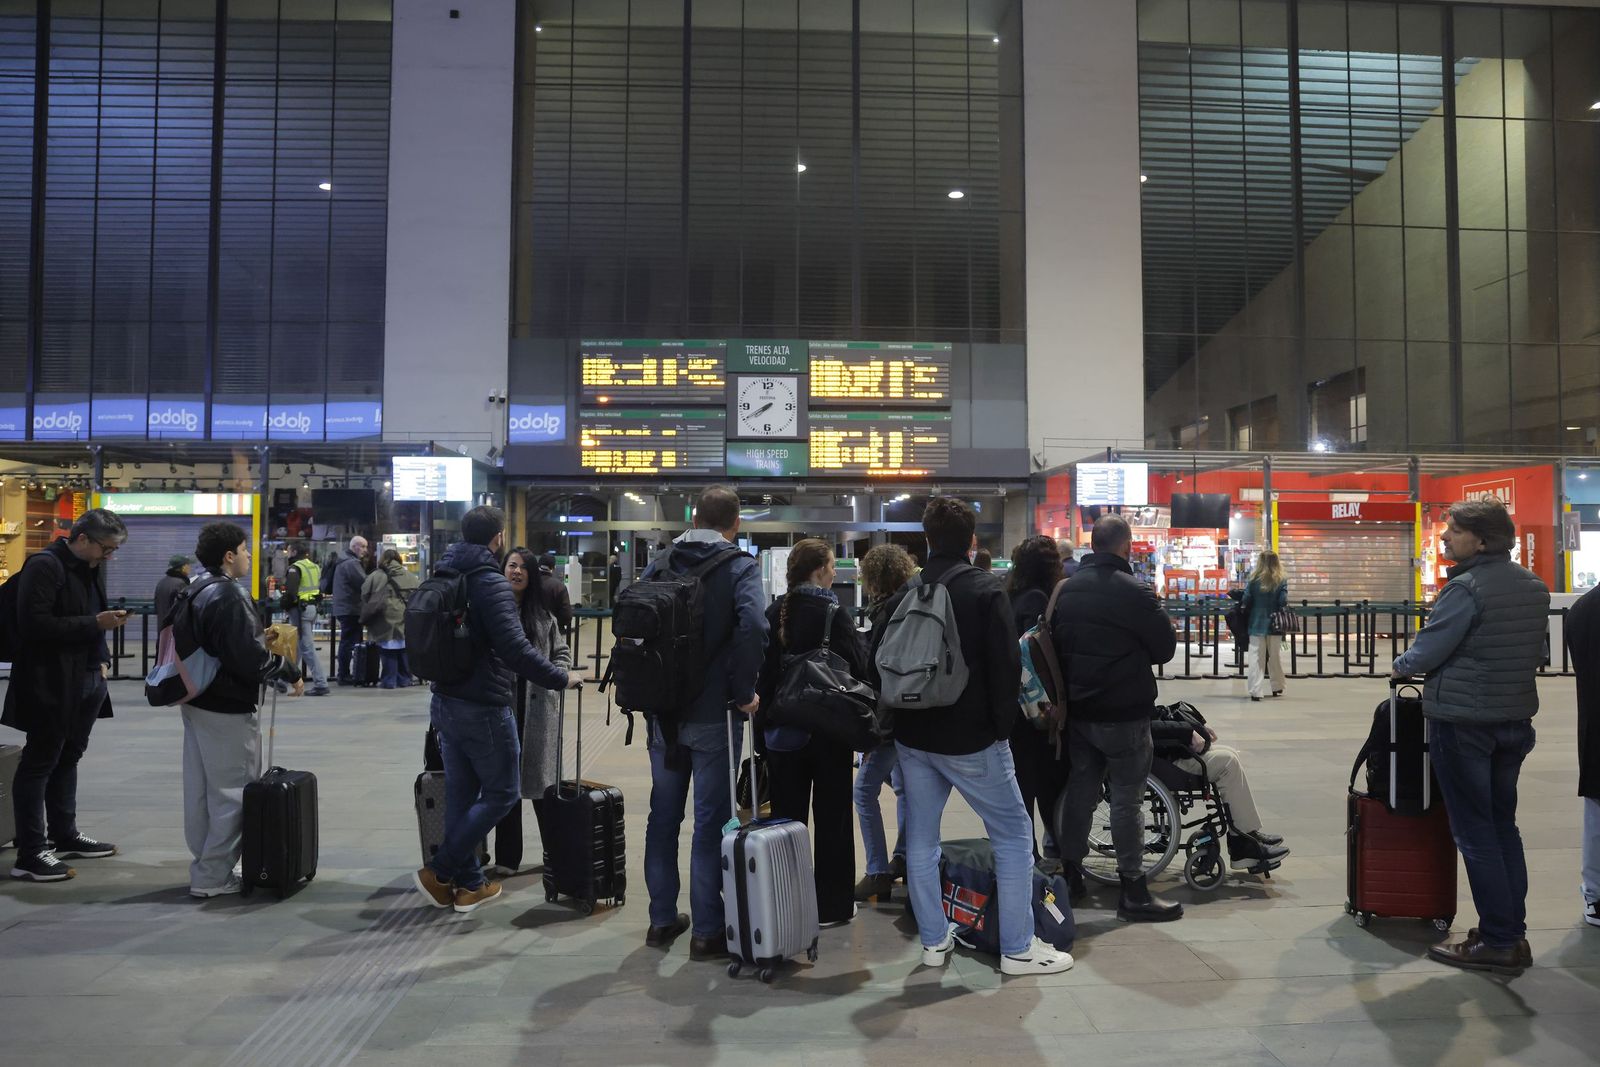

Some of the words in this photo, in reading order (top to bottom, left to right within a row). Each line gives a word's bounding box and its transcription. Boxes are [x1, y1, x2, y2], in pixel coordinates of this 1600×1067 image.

[746, 345, 771, 354] TRENES
[773, 345, 790, 355] ALTA
[749, 356, 787, 365] VELOCIDAD
[762, 382, 774, 390] 12
[742, 402, 750, 410] 9
[785, 403, 793, 411] 3
[746, 449, 764, 459] HIGH
[766, 449, 789, 459] SPEED
[756, 460, 780, 469] TRAINS
[1332, 502, 1360, 519] RELAY
[1568, 524, 1577, 548] A
[1526, 532, 1535, 572] RE
